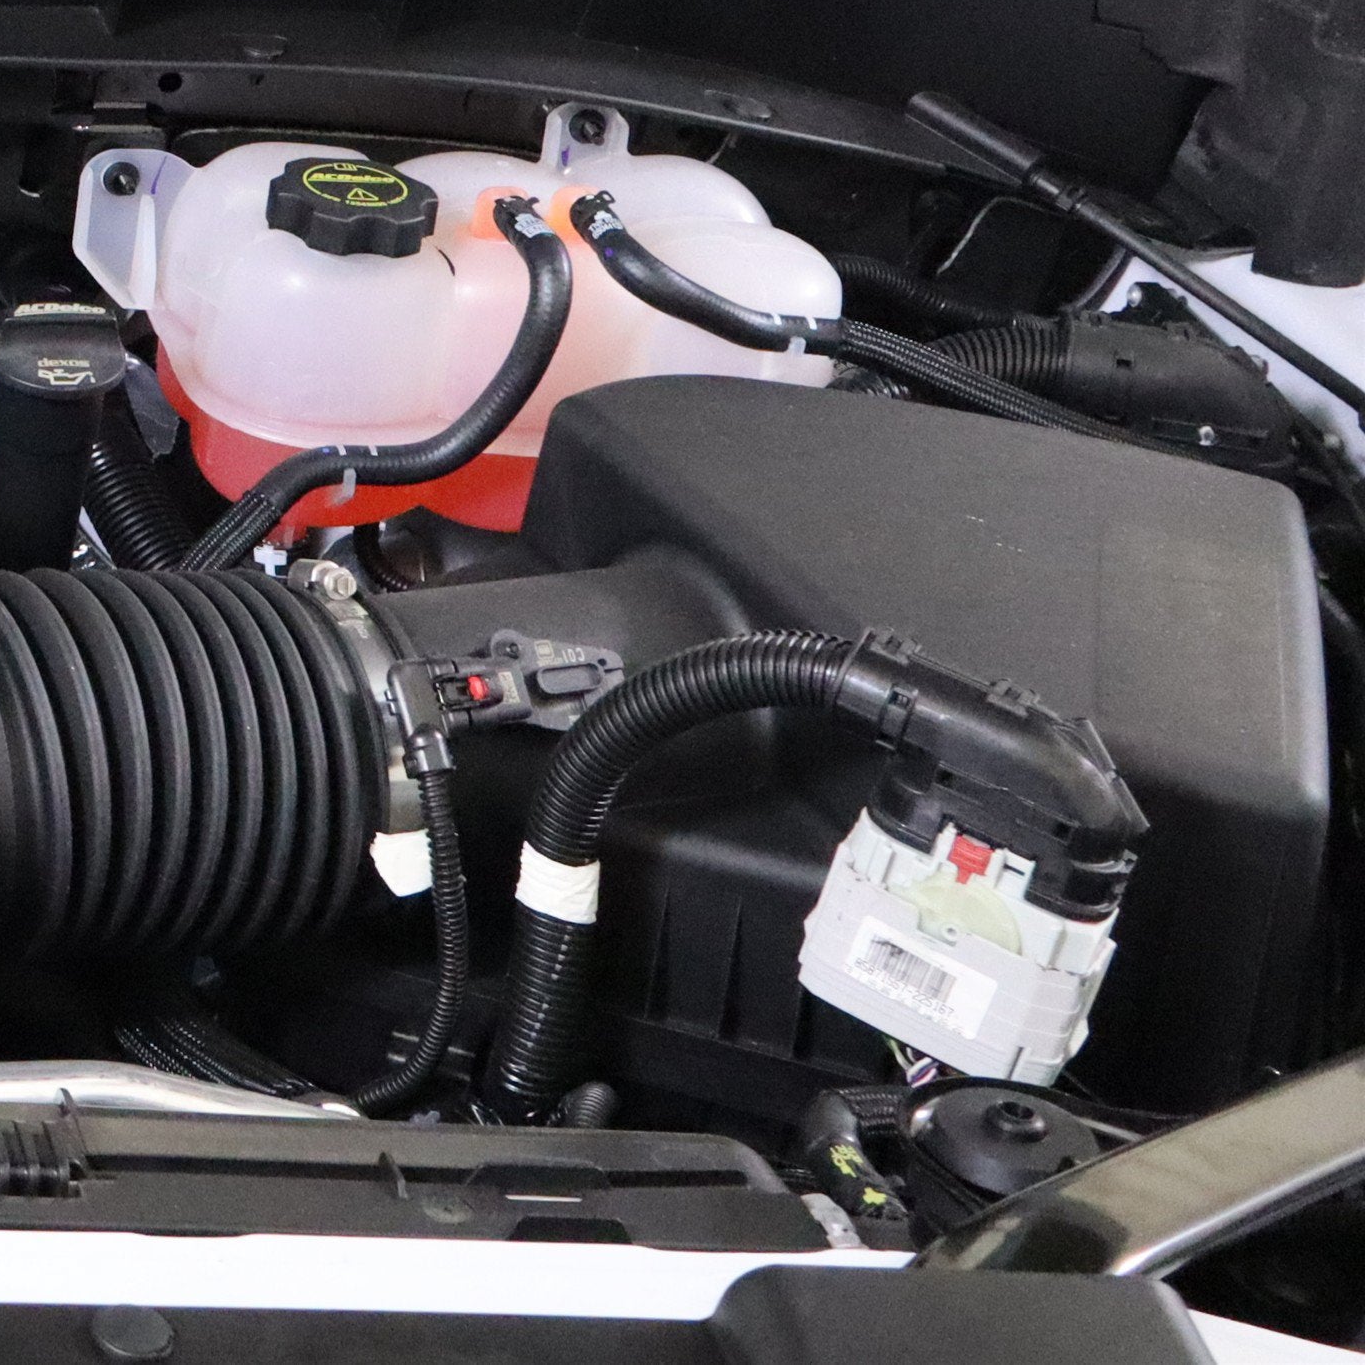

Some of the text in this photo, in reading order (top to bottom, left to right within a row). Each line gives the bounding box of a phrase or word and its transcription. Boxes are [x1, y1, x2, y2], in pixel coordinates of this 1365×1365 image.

[308, 173, 395, 184] ACDelco
[14, 302, 106, 317] ACDelco
[37, 357, 90, 368] dexos
